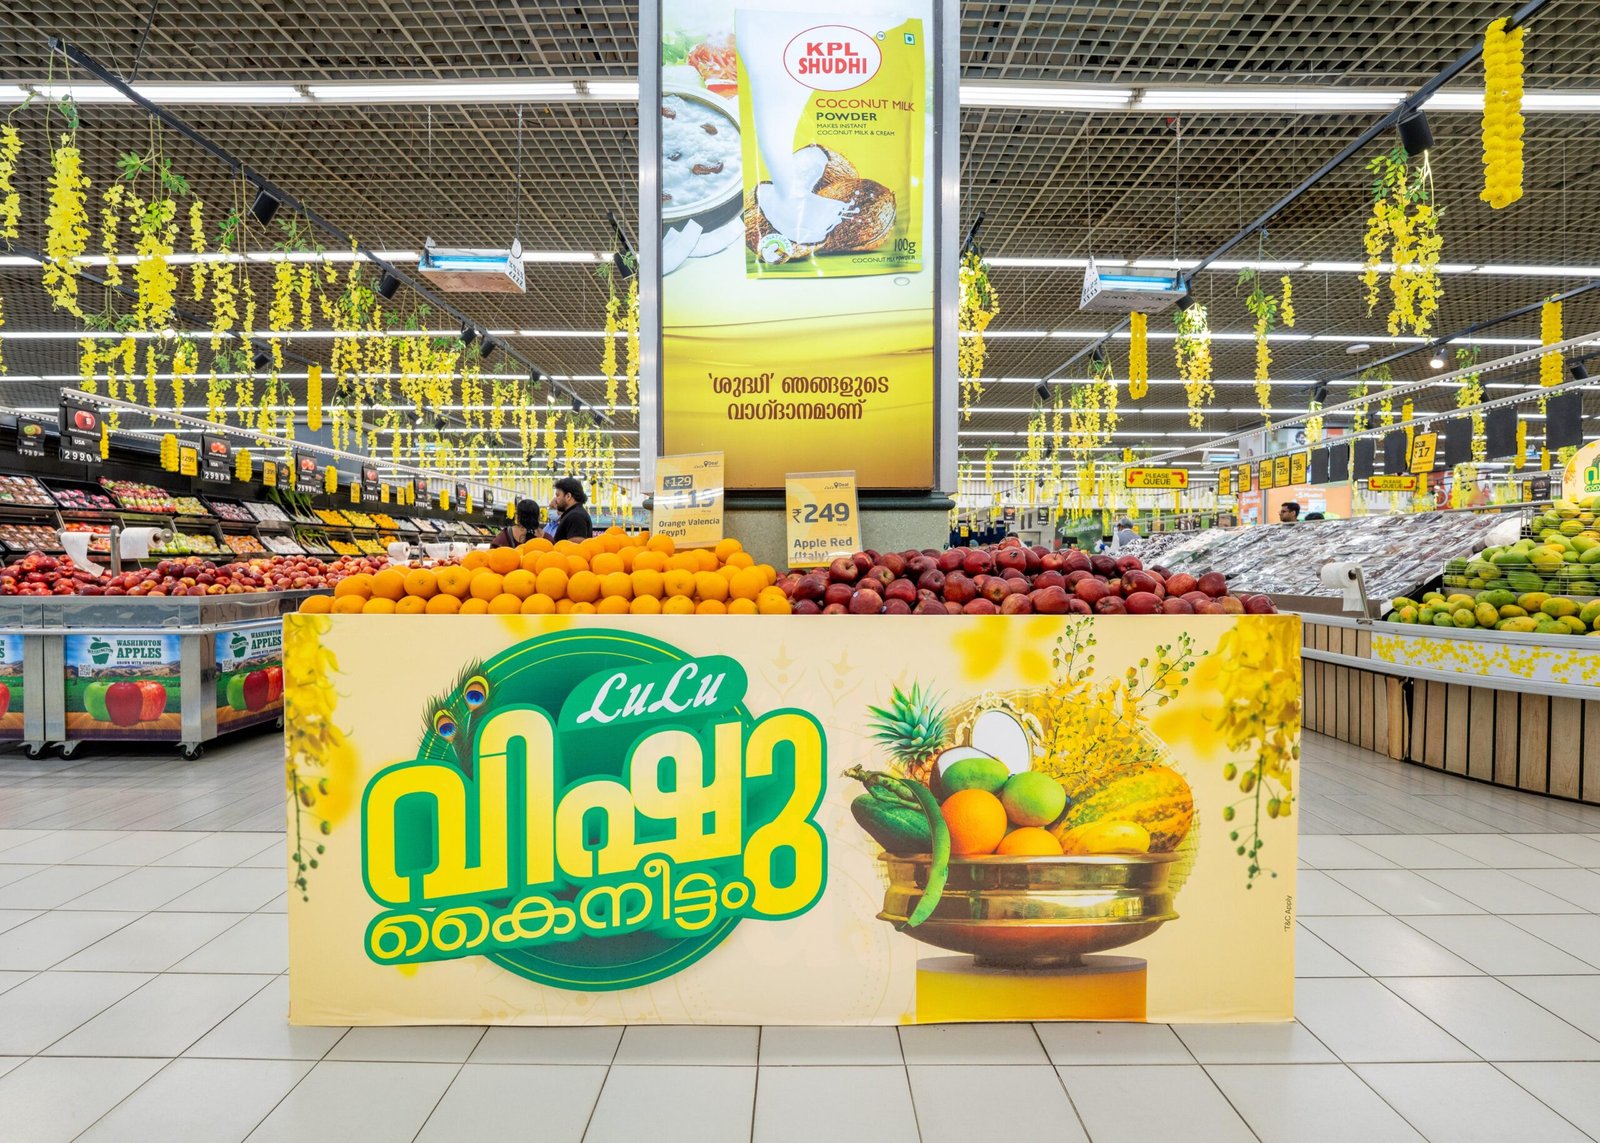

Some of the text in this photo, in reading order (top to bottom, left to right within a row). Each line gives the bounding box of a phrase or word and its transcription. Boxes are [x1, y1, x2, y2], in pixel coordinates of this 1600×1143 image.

[807, 42, 859, 56] KPL
[798, 58, 867, 74] SHUDHI
[816, 98, 915, 112] COCONUT MILK
[816, 112, 878, 121] POWDER
[894, 238, 916, 254] 100g
[794, 536, 853, 550] Apple Red
[251, 636, 282, 650] APPLES
[116, 648, 162, 658] APPLES
[575, 662, 726, 724] LuLu
[1284, 894, 1293, 914] Apply
